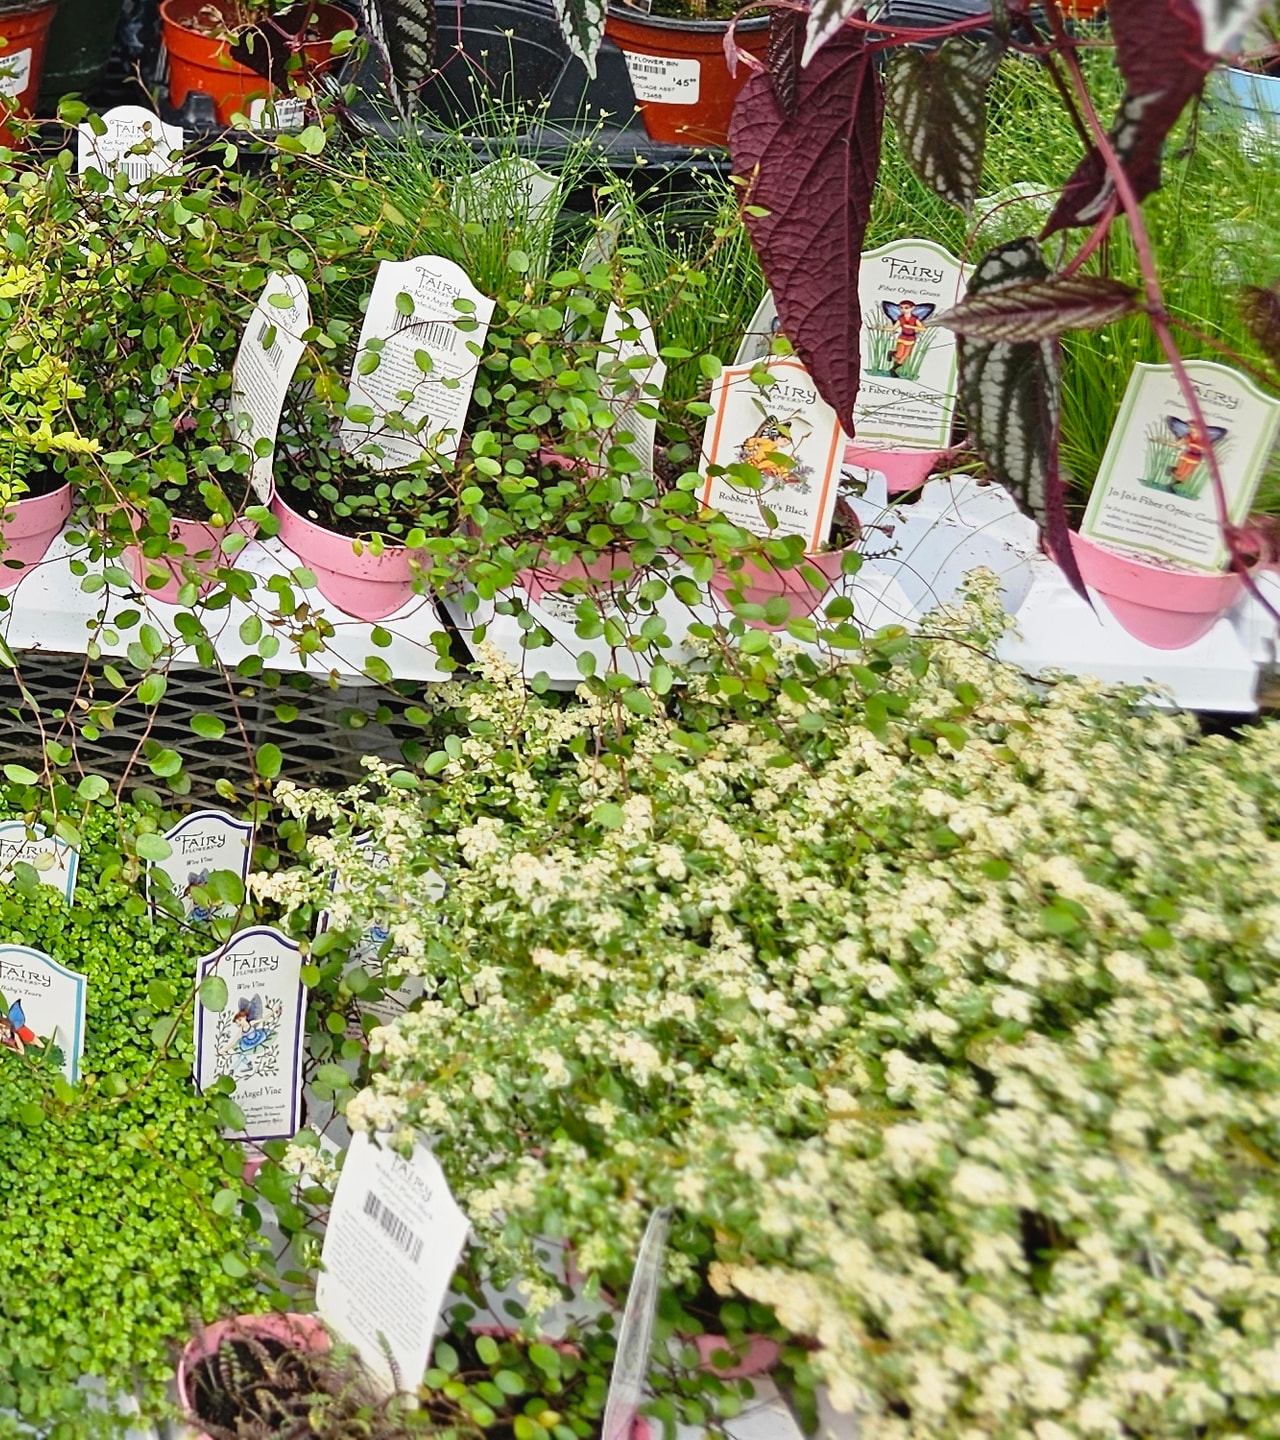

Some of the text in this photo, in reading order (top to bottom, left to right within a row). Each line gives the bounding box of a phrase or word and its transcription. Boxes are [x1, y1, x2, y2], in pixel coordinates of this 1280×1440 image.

[881, 256, 944, 283] FAIRY
[415, 266, 461, 300] FAIRY
[768, 379, 817, 404] AIRY
[868, 385, 891, 394] Fiber
[718, 491, 754, 505] Robbie's
[784, 505, 809, 517] Black
[1139, 496, 1163, 509] Fiber
[174, 831, 226, 855] FAIRY
[225, 950, 279, 977] FAIRY
[236, 966, 270, 977] FLOWERS
[236, 980, 266, 990] Wire Vine
[242, 1086, 282, 1099] Angel Vine
